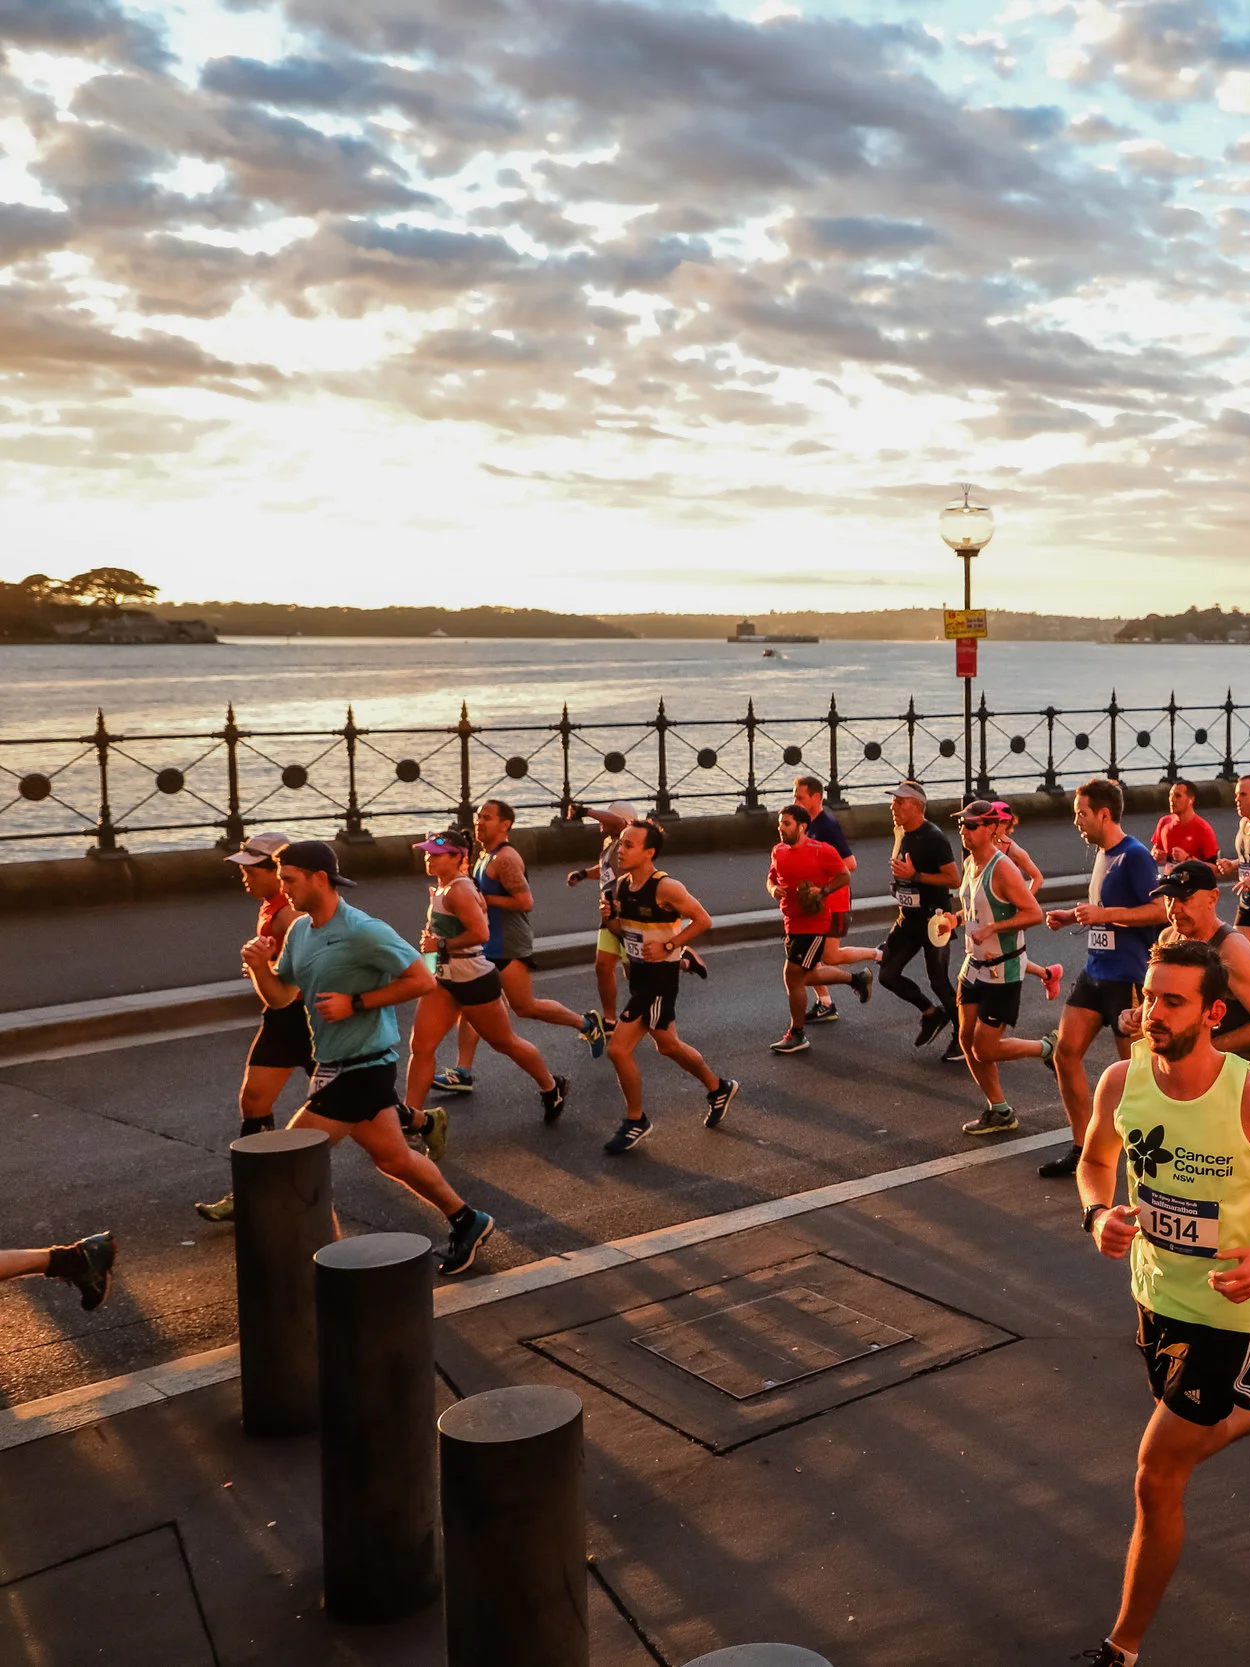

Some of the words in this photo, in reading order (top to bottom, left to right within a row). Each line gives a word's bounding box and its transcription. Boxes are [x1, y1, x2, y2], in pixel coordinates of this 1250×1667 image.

[1174, 1147, 1234, 1165] Cancer
[1174, 1160, 1233, 1178] Council
[1172, 1173, 1195, 1184] NSW
[1151, 1198, 1198, 1215] halfmarathon
[1150, 1210, 1199, 1243] 1514
